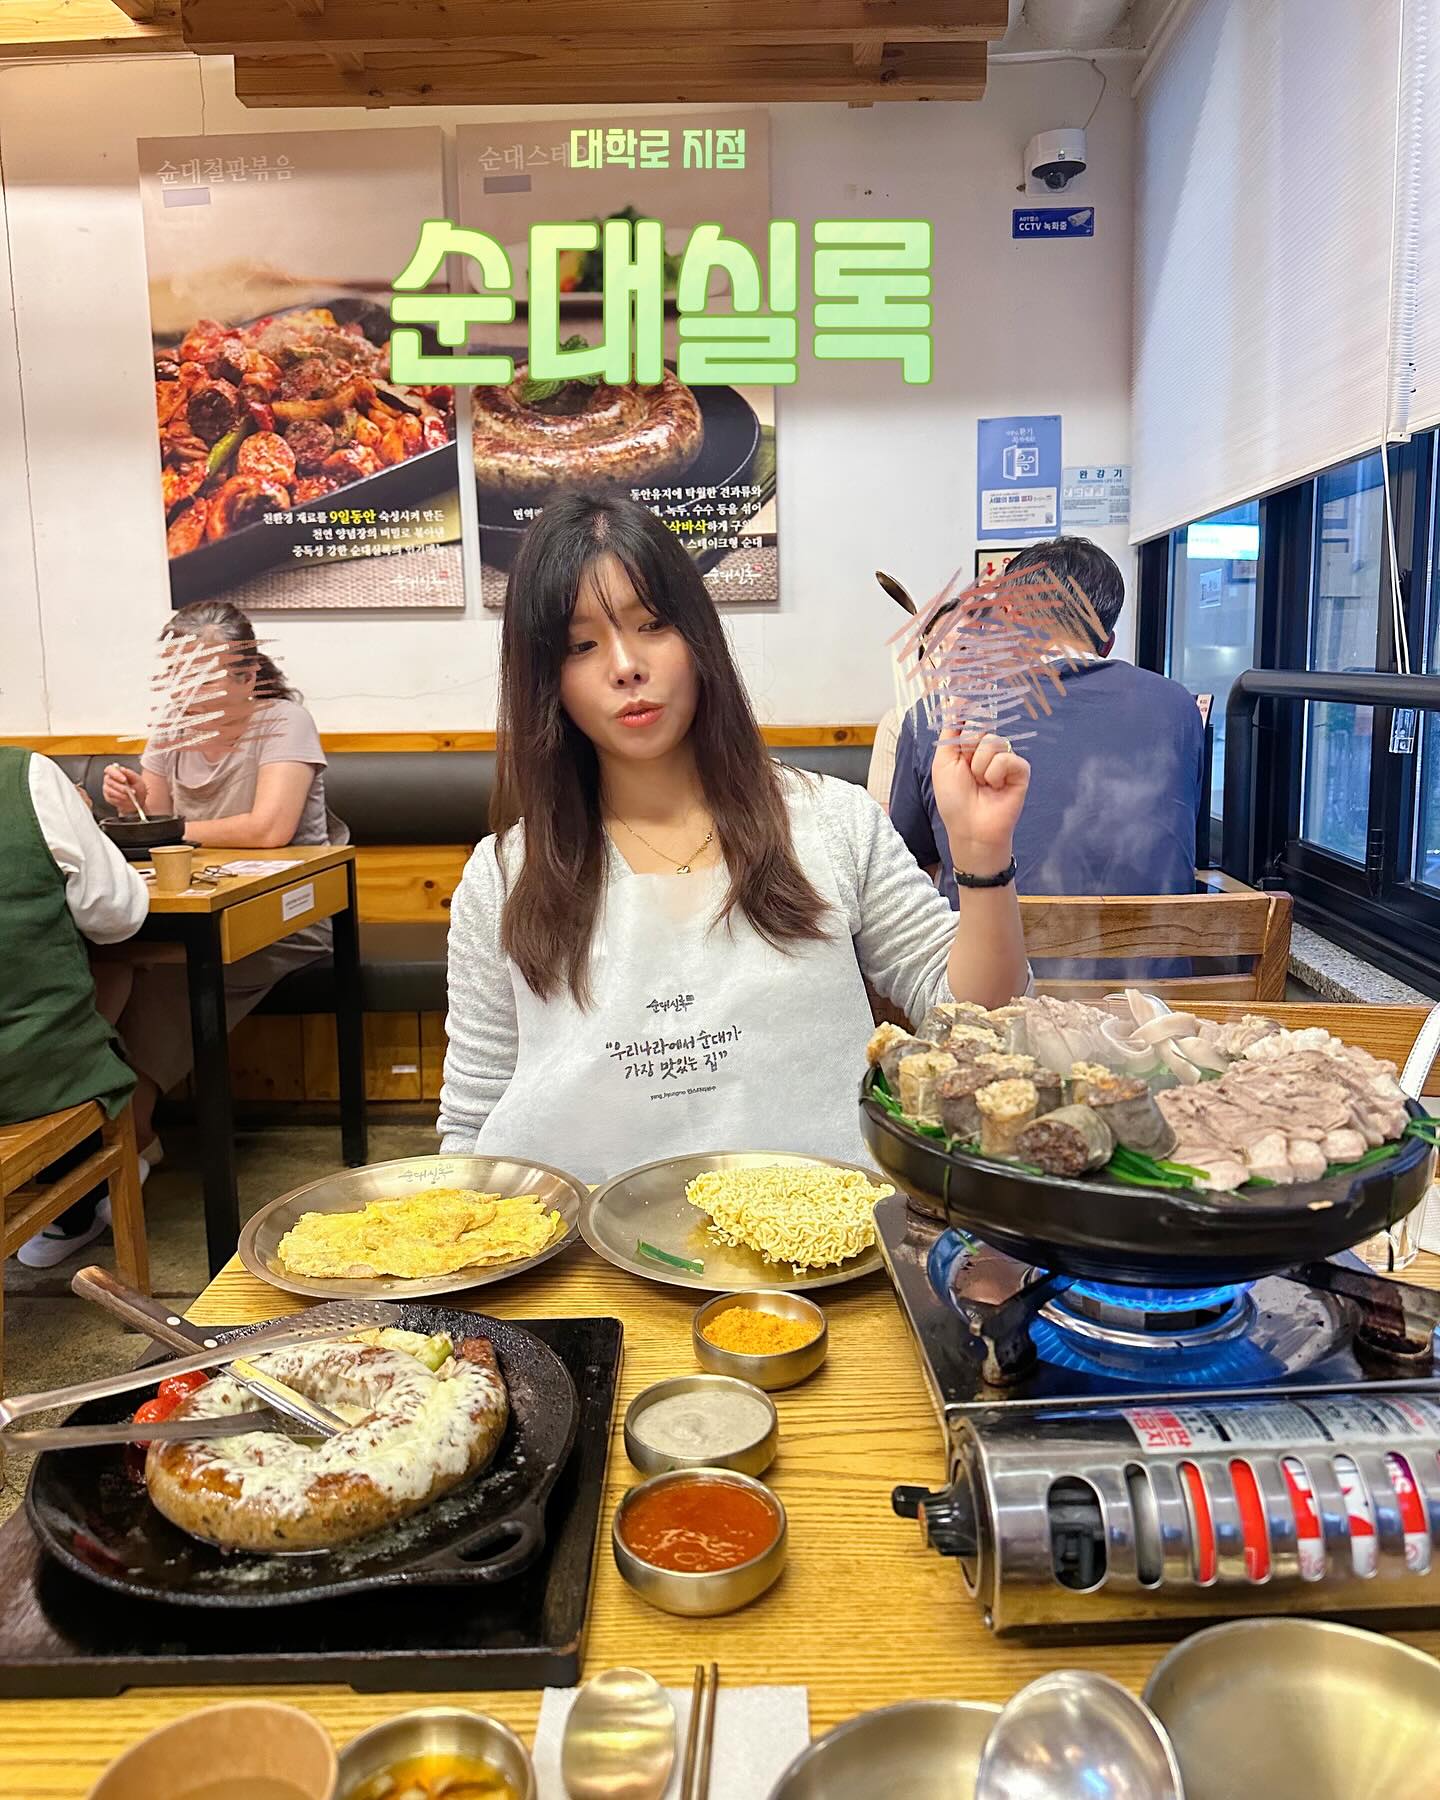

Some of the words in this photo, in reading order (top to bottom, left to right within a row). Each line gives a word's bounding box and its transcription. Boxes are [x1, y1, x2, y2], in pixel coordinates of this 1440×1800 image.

[156, 154, 295, 185] 순대철판볶음
[1019, 222, 1041, 231] CCTV
[1044, 221, 1067, 231] 녹화중
[719, 484, 762, 499] 견과류와
[329, 509, 377, 525] 9일동안
[378, 510, 421, 523] 숙성시켜
[422, 510, 445, 522] 만든
[692, 503, 714, 517] 수수
[717, 503, 740, 516] 등을
[742, 536, 762, 548] 순대
[697, 1025, 743, 1050] 순대가
[625, 1061, 654, 1080] 가장
[660, 1056, 699, 1080] 맛있는
